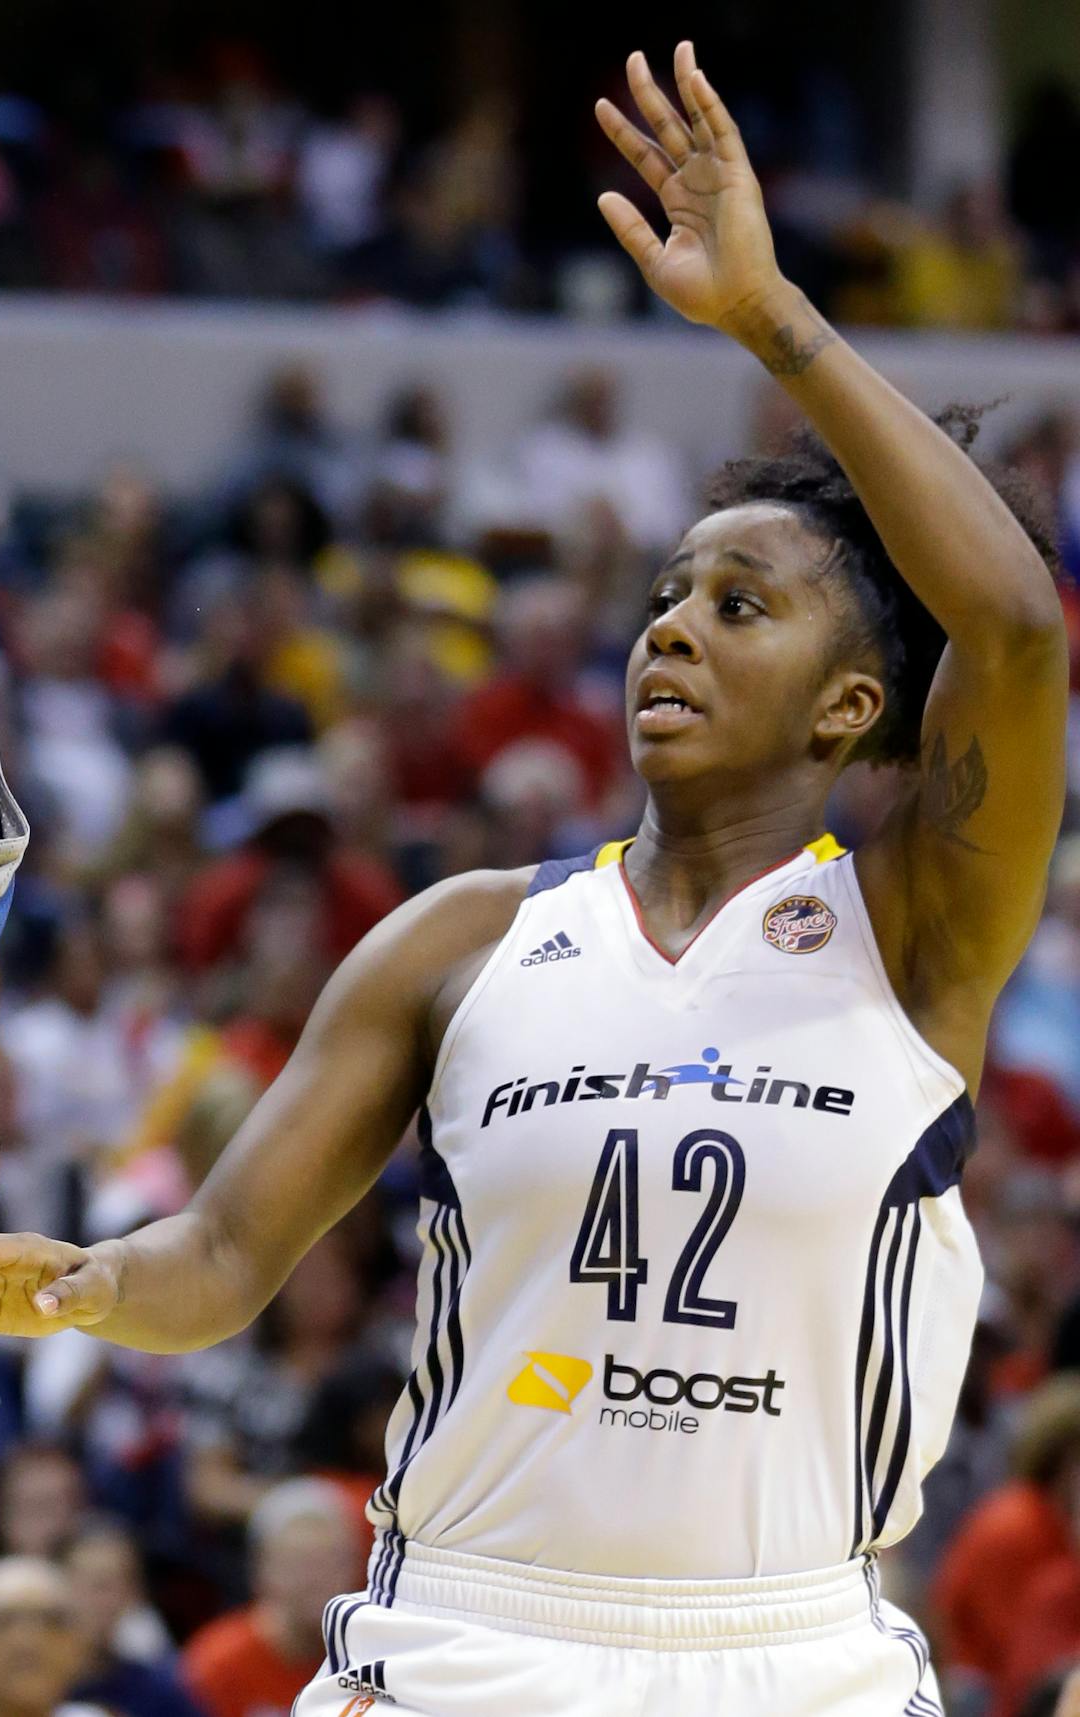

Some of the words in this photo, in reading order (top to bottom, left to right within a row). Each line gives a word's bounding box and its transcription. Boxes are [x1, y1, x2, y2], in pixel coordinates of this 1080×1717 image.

[764, 909, 837, 942] Fever
[520, 947, 582, 967] adidas
[570, 1128, 746, 1330] 42
[603, 1354, 786, 1417] boost
[599, 1407, 700, 1434] mobile
